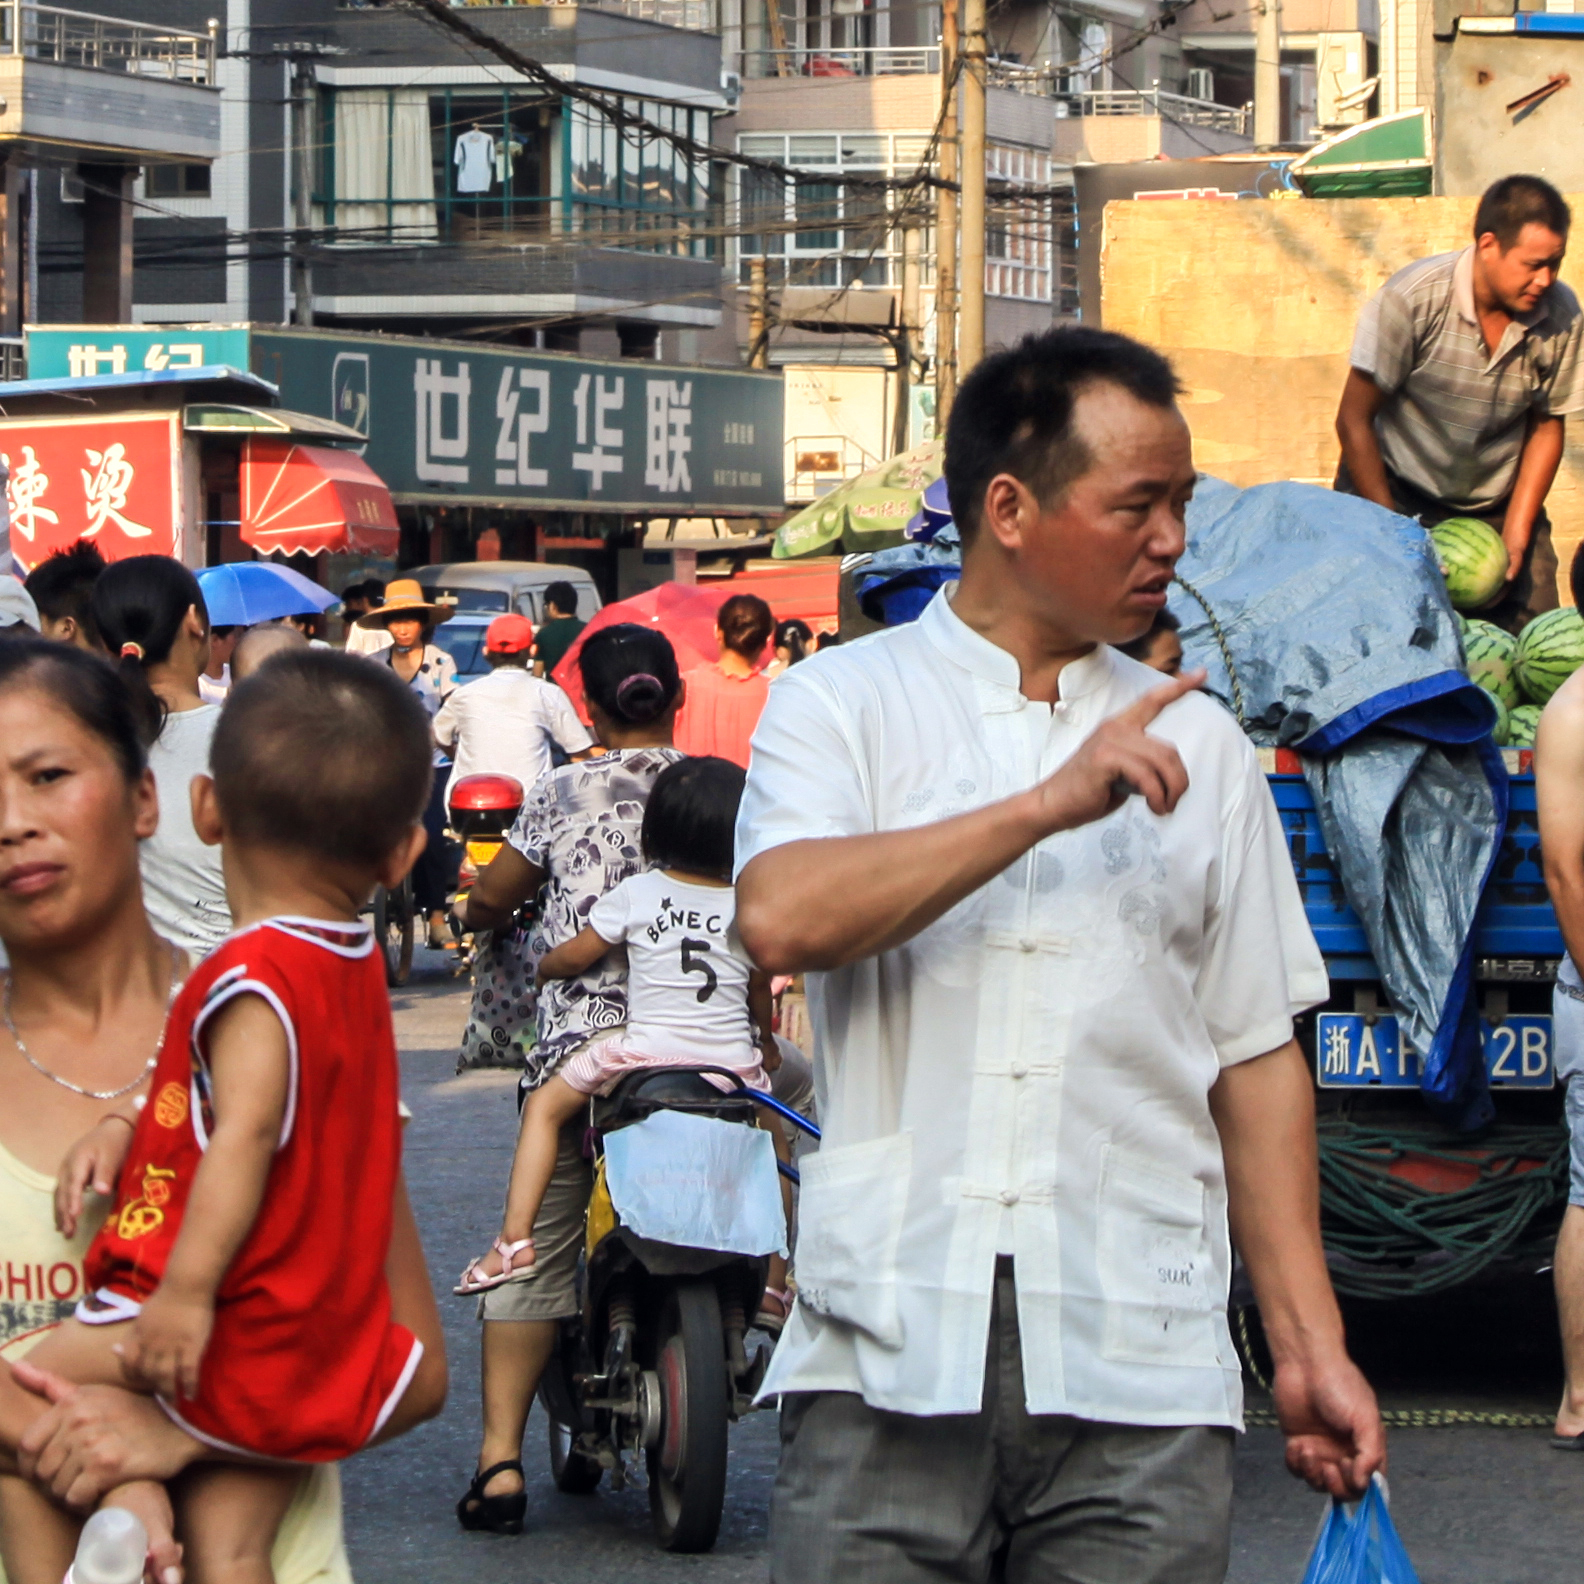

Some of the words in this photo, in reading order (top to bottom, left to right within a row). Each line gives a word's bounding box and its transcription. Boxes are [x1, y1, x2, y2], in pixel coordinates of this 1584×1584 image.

[413, 358, 693, 493] 世纪华联
[681, 936, 718, 1003] 5
